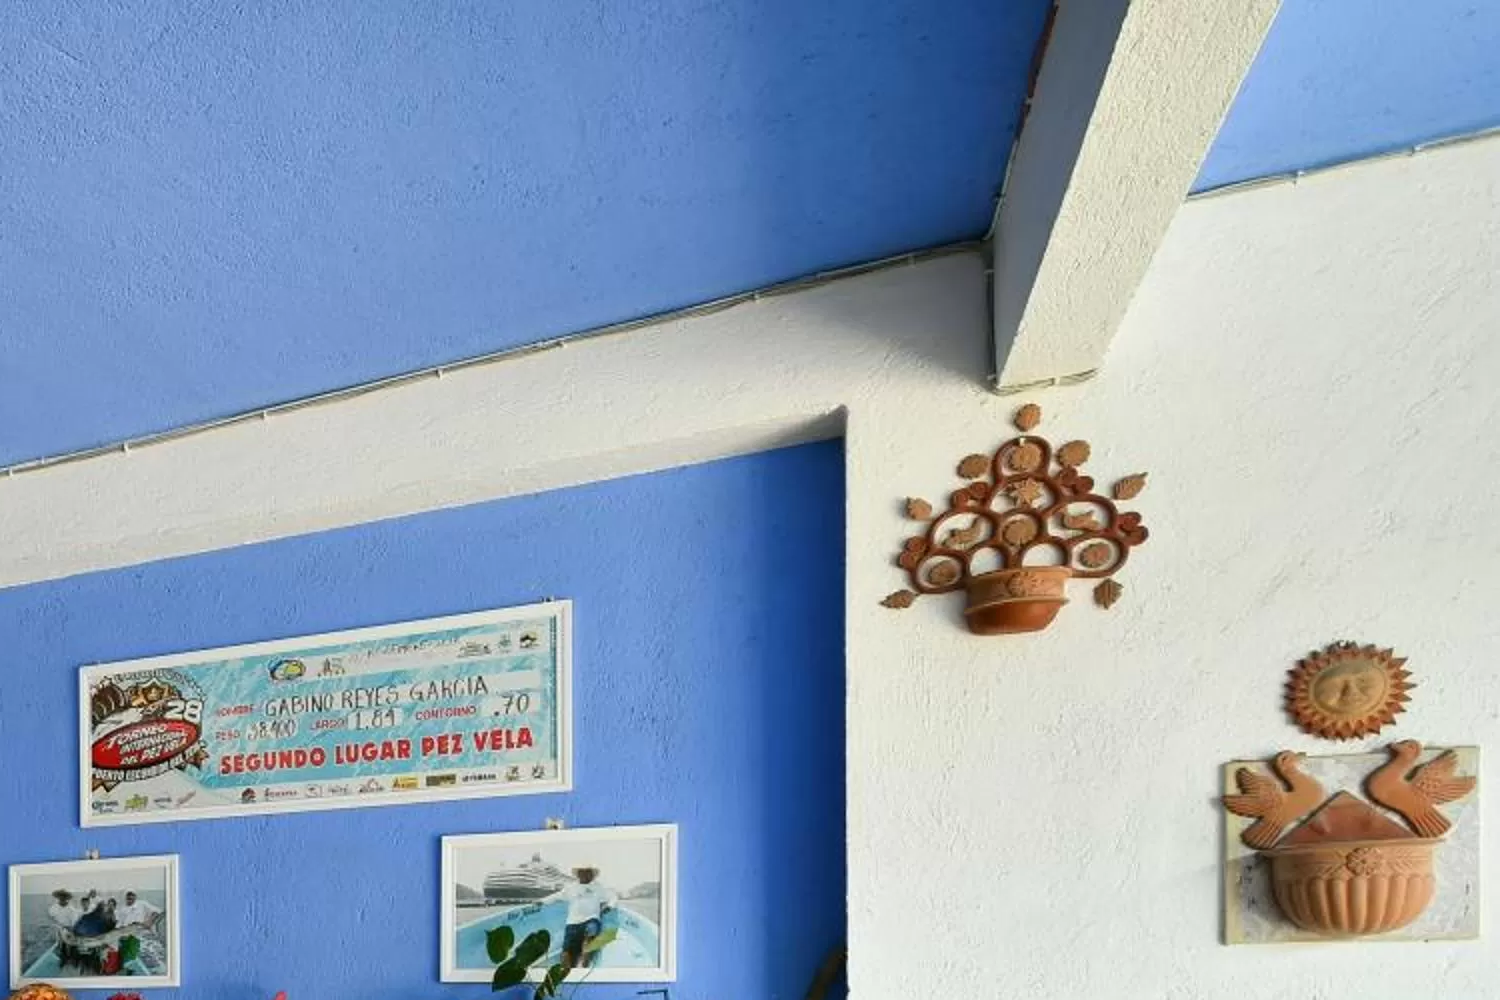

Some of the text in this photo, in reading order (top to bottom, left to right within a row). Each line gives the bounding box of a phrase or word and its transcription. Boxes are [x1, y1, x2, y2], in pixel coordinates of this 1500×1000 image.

[165, 698, 202, 723] 28
[265, 694, 333, 717] GABINO
[341, 684, 400, 710] REYES
[409, 675, 489, 702] GARCIA
[415, 705, 477, 721] CONTORNO
[220, 727, 534, 775] SEGUNDO LUGAR PEZ VELA
